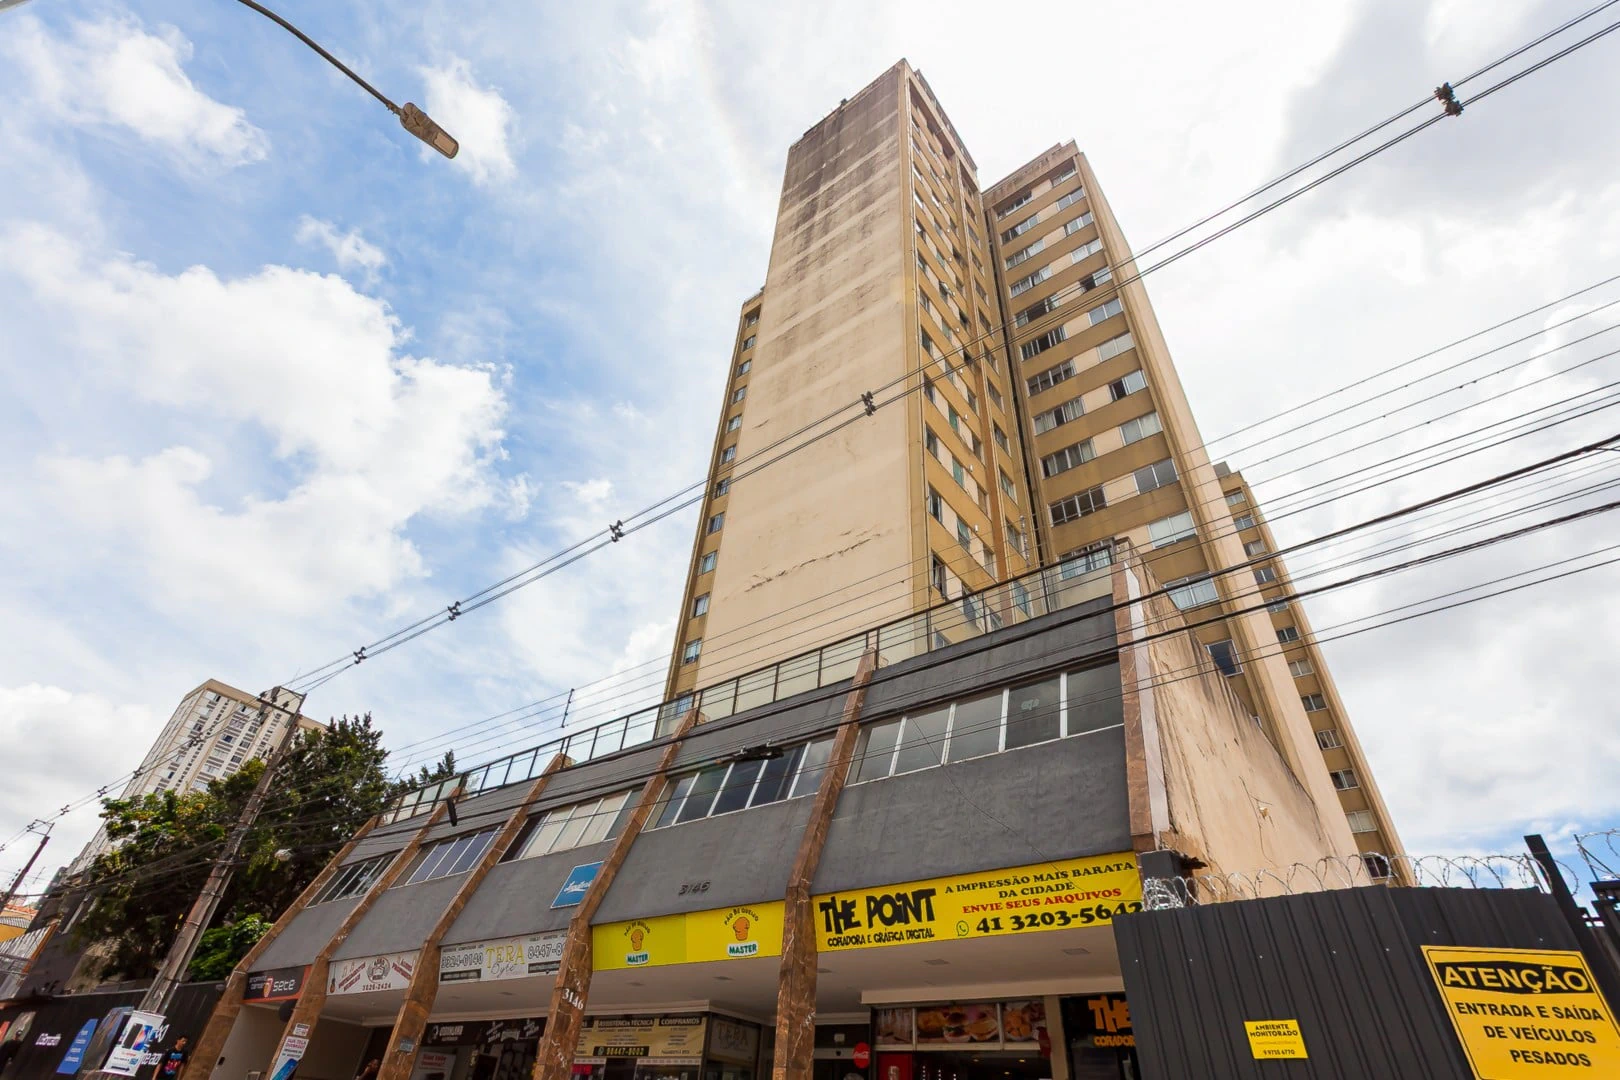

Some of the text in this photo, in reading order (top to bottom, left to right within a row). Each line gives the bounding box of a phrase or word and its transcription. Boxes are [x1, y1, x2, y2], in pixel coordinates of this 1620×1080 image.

[945, 861, 1134, 894] A IMPRESSÃO MAIS BARATA
[678, 882, 711, 896] 3146
[998, 882, 1075, 899] DA CIDADE
[963, 888, 1122, 914] ENVIE SEUS ARQUIVOS
[819, 896, 862, 934] THE
[976, 917, 1004, 933] 41
[906, 928, 935, 940] DIGITAL
[485, 944, 526, 969] TERA
[628, 953, 648, 963] MASTER
[729, 943, 757, 954] MASTER
[1444, 966, 1588, 993] ATENÇÃO
[562, 988, 584, 1010] 3146
[661, 1017, 700, 1026] COMPRAMOS
[1088, 995, 1132, 1032] THE
[1455, 1002, 1605, 1022] ENTRADA E SAÍDA
[1483, 1024, 1597, 1044] DE VEÍCULOS
[1510, 1049, 1592, 1068] PESADOS
